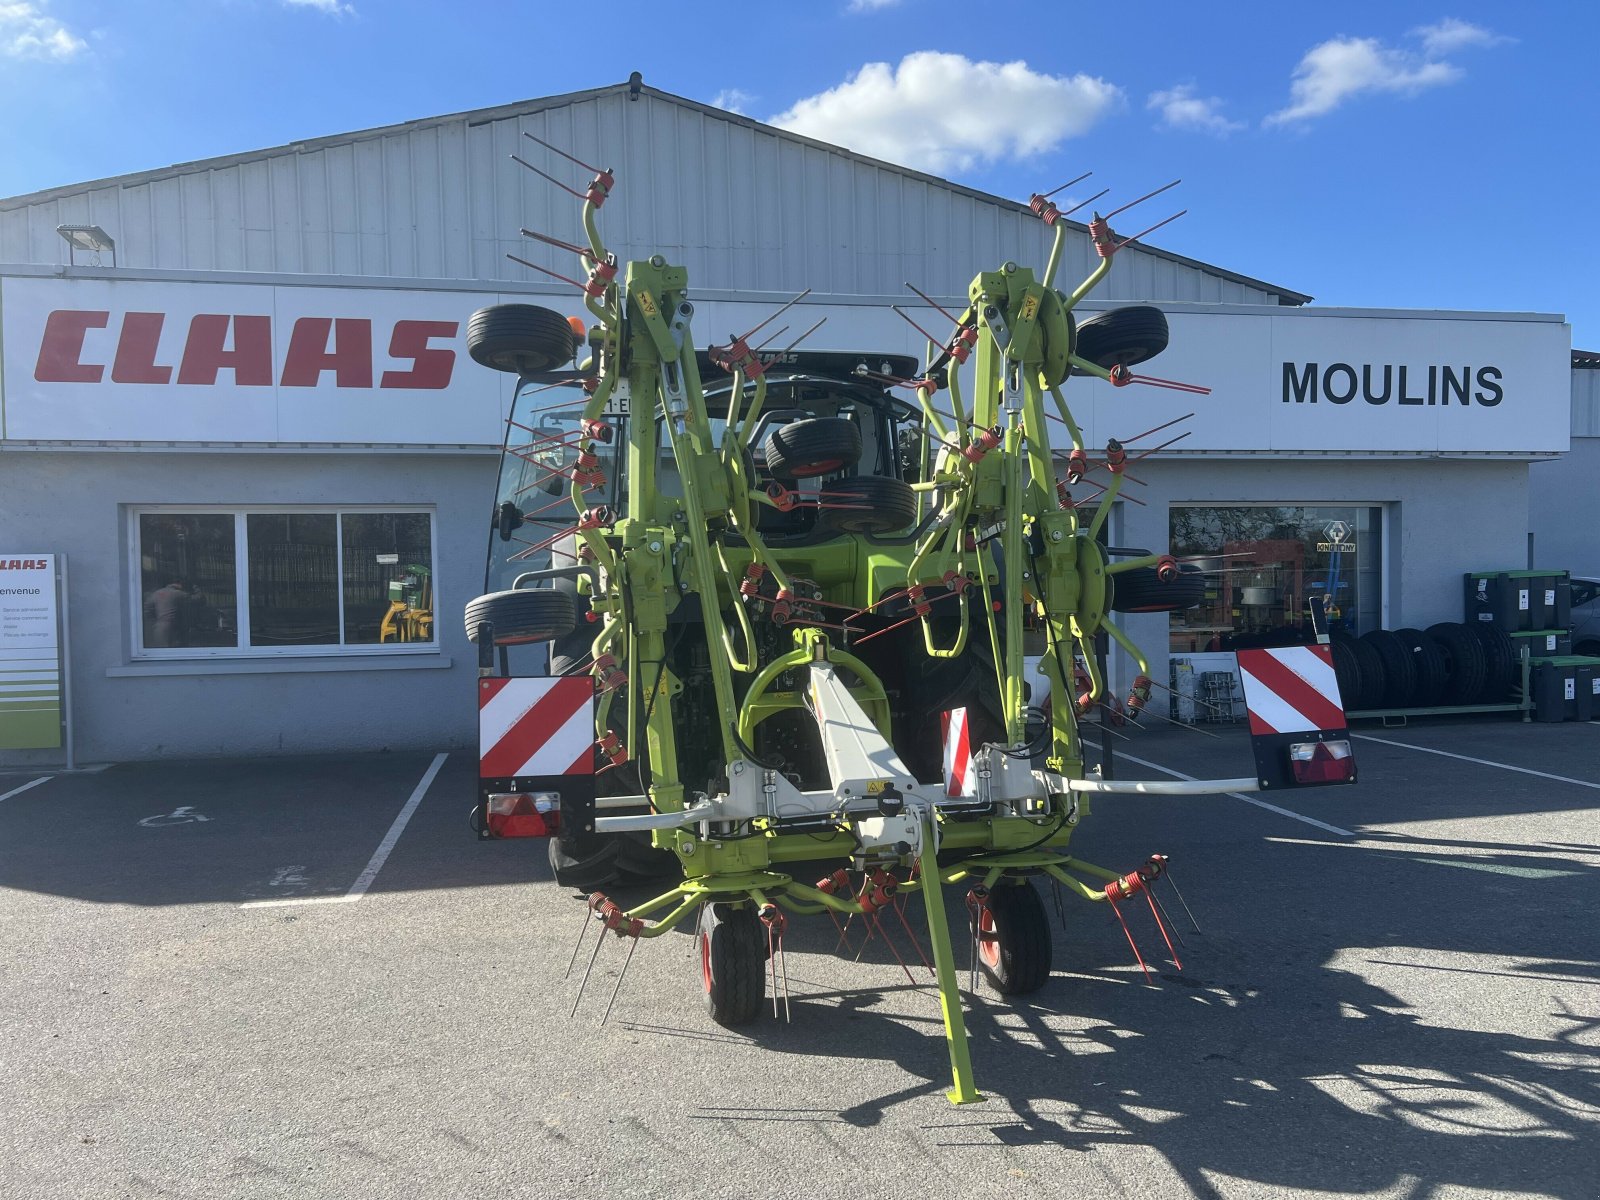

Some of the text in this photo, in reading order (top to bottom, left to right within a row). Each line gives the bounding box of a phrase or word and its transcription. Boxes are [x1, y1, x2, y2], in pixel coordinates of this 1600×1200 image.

[34, 310, 459, 390] CLAAS
[1281, 361, 1504, 407] MOULINS
[602, 398, 631, 413] 1-E
[1317, 543, 1335, 552] KING
[0, 559, 47, 570] LAAS
